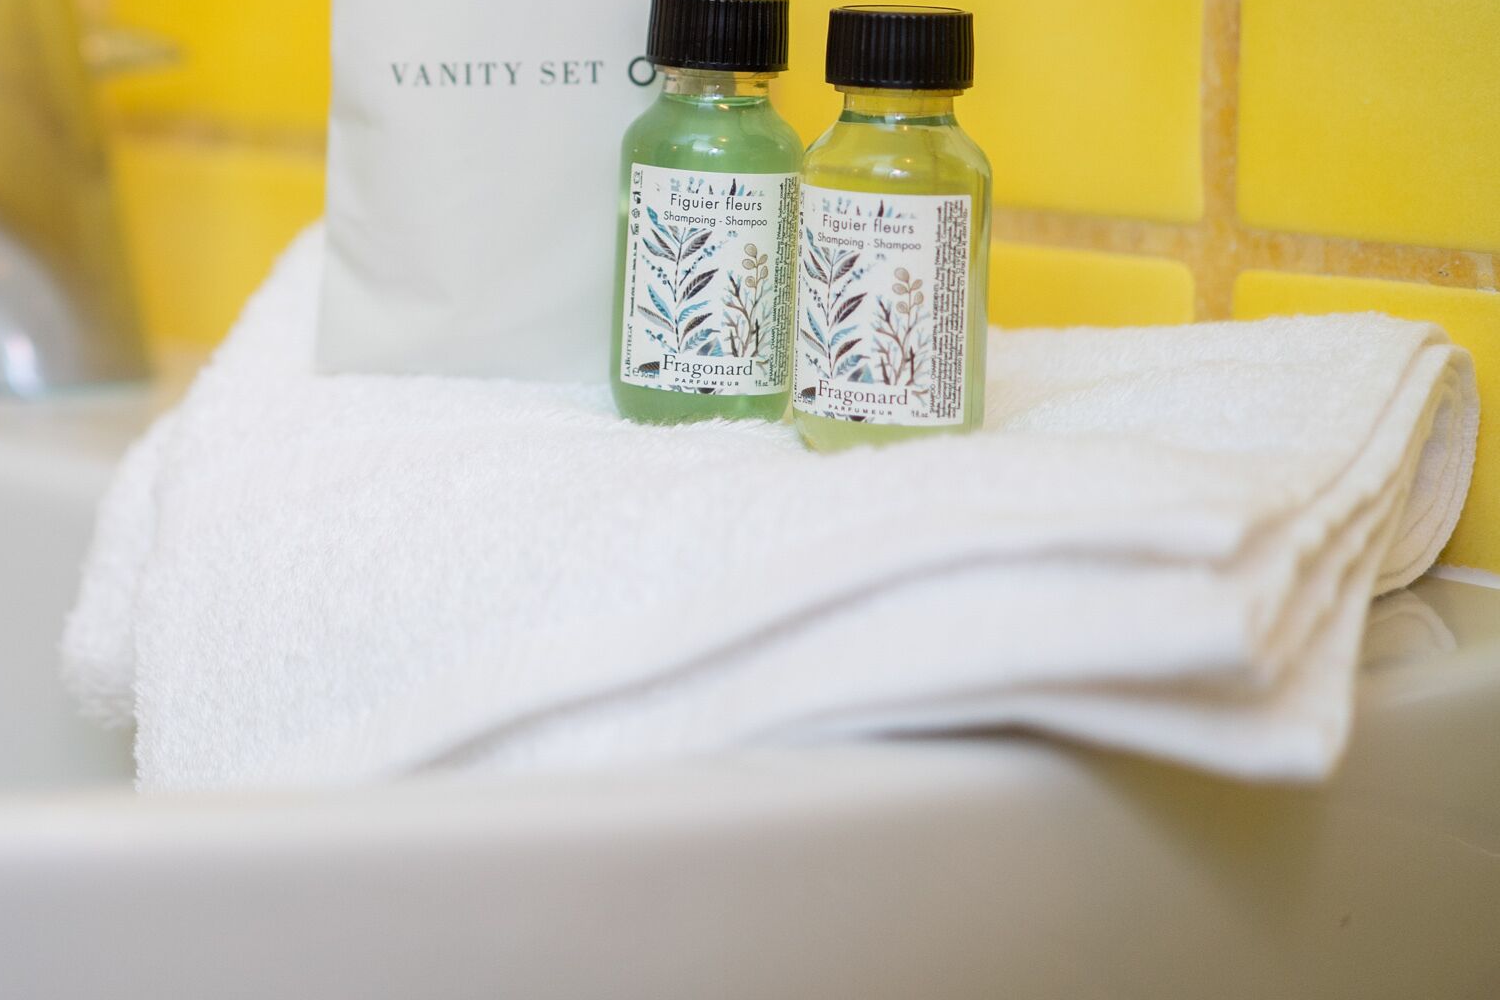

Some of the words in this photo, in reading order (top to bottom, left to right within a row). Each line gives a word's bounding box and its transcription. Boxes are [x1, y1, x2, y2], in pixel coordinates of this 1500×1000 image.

[391, 61, 523, 86] VANITY
[540, 60, 605, 85] SET
[670, 193, 720, 211] Figuier
[726, 196, 762, 211] fleurs
[663, 210, 716, 227] Shampoing
[725, 215, 768, 228] Shampoo
[822, 213, 867, 232] Figuier
[873, 217, 915, 234] fleurs
[817, 231, 864, 249] Shampoing
[873, 238, 921, 250] Shampoo
[662, 353, 753, 378] Fragonard
[674, 377, 740, 387] PARFUMEUR
[817, 379, 908, 406] Fragonard
[828, 403, 893, 416] PARFUMEUR
